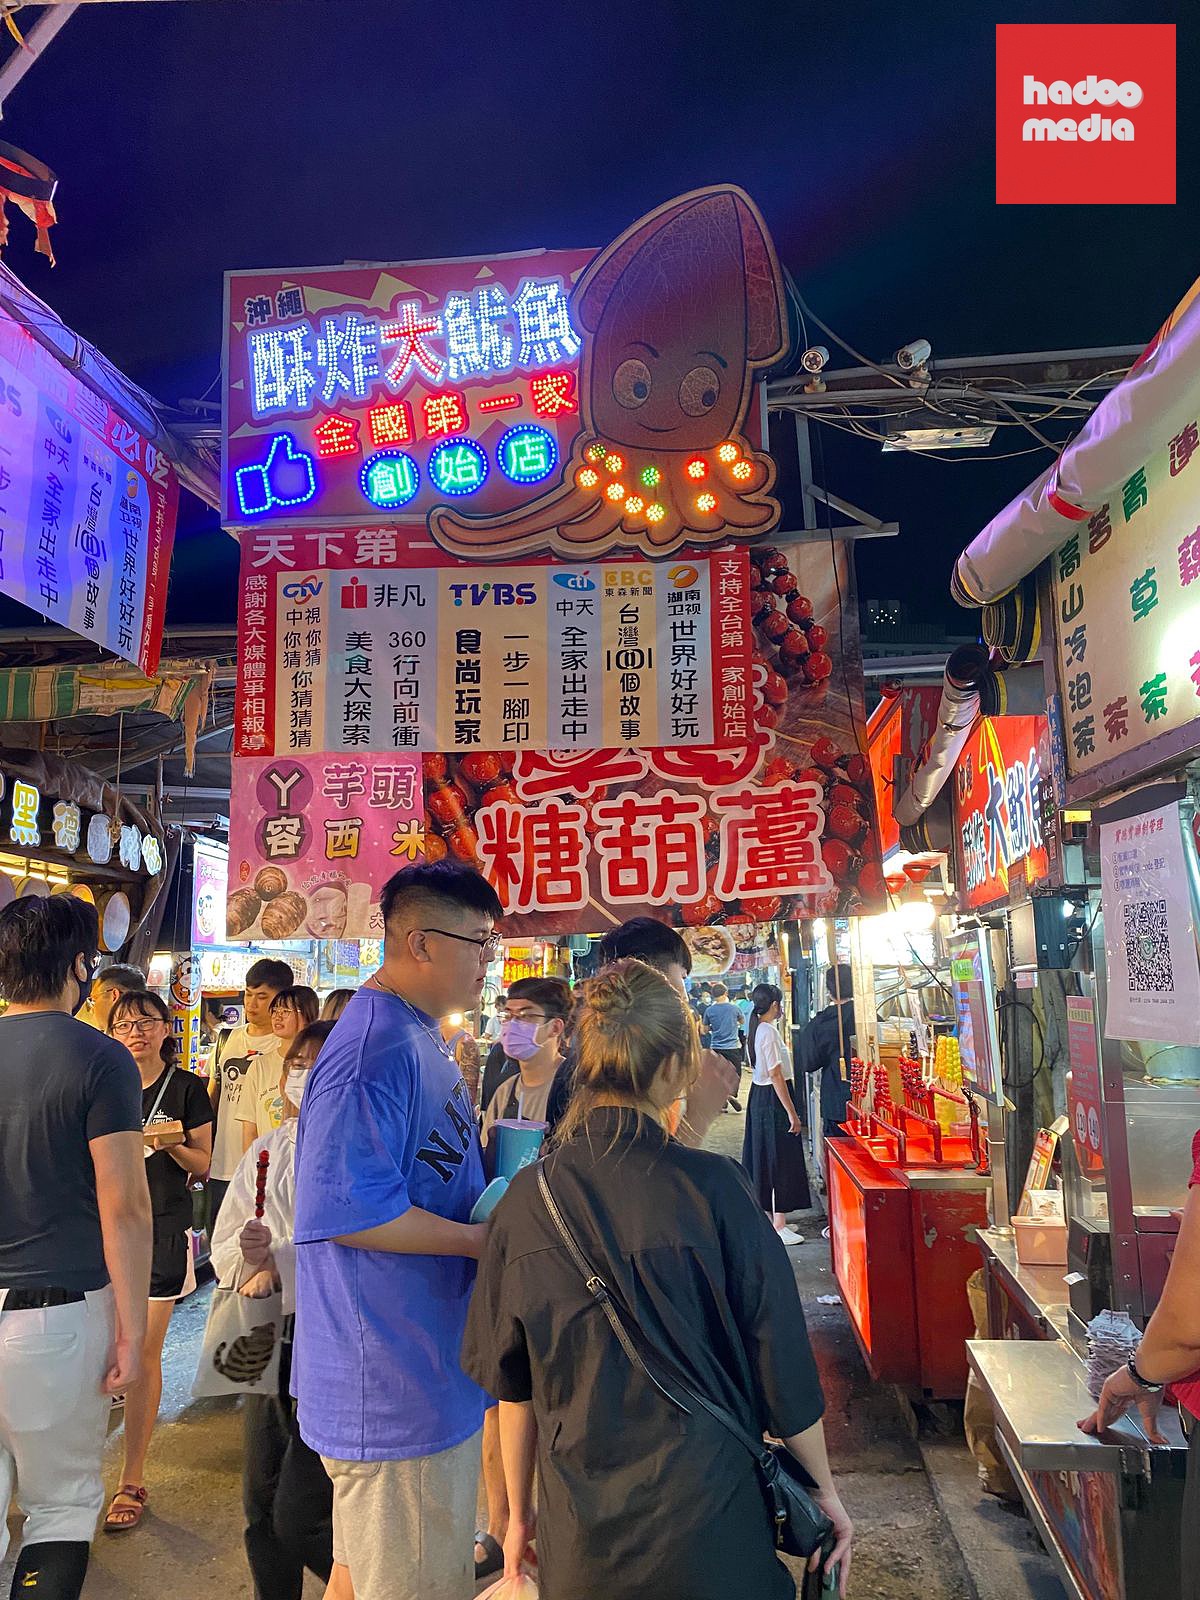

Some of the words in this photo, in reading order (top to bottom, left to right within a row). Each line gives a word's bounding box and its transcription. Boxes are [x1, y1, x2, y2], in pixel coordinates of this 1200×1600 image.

[244, 286, 305, 325] 沖繩
[249, 281, 583, 413] 酥炸大魷魚
[314, 373, 577, 457] 全國第一家
[367, 432, 549, 506] 創始店
[117, 526, 140, 651] 世界好好玩
[286, 608, 322, 626] 中視
[374, 584, 426, 607] 非凡
[448, 582, 537, 607] TVBS
[556, 599, 594, 616] 中天
[604, 569, 653, 587] EBC
[604, 587, 653, 597] 東森新聞
[667, 590, 701, 604] 湖南
[667, 604, 701, 616] 卫视
[1122, 466, 1168, 723] 青草茶
[241, 574, 268, 751] 感謝各大媒體爭相報導
[454, 629, 482, 745] 食尚玩家
[560, 626, 589, 742] 全家出走中
[669, 619, 700, 739] 世界好好玩
[719, 559, 748, 738] 支持全台第一家創始店
[1059, 533, 1096, 759] 高山冷泡茶
[342, 631, 373, 746] 美食大探索
[502, 634, 531, 744] 一步一腳印
[322, 762, 417, 810] 芋頭
[324, 816, 425, 861] 西米
[475, 780, 834, 914] 糖葫蘆
